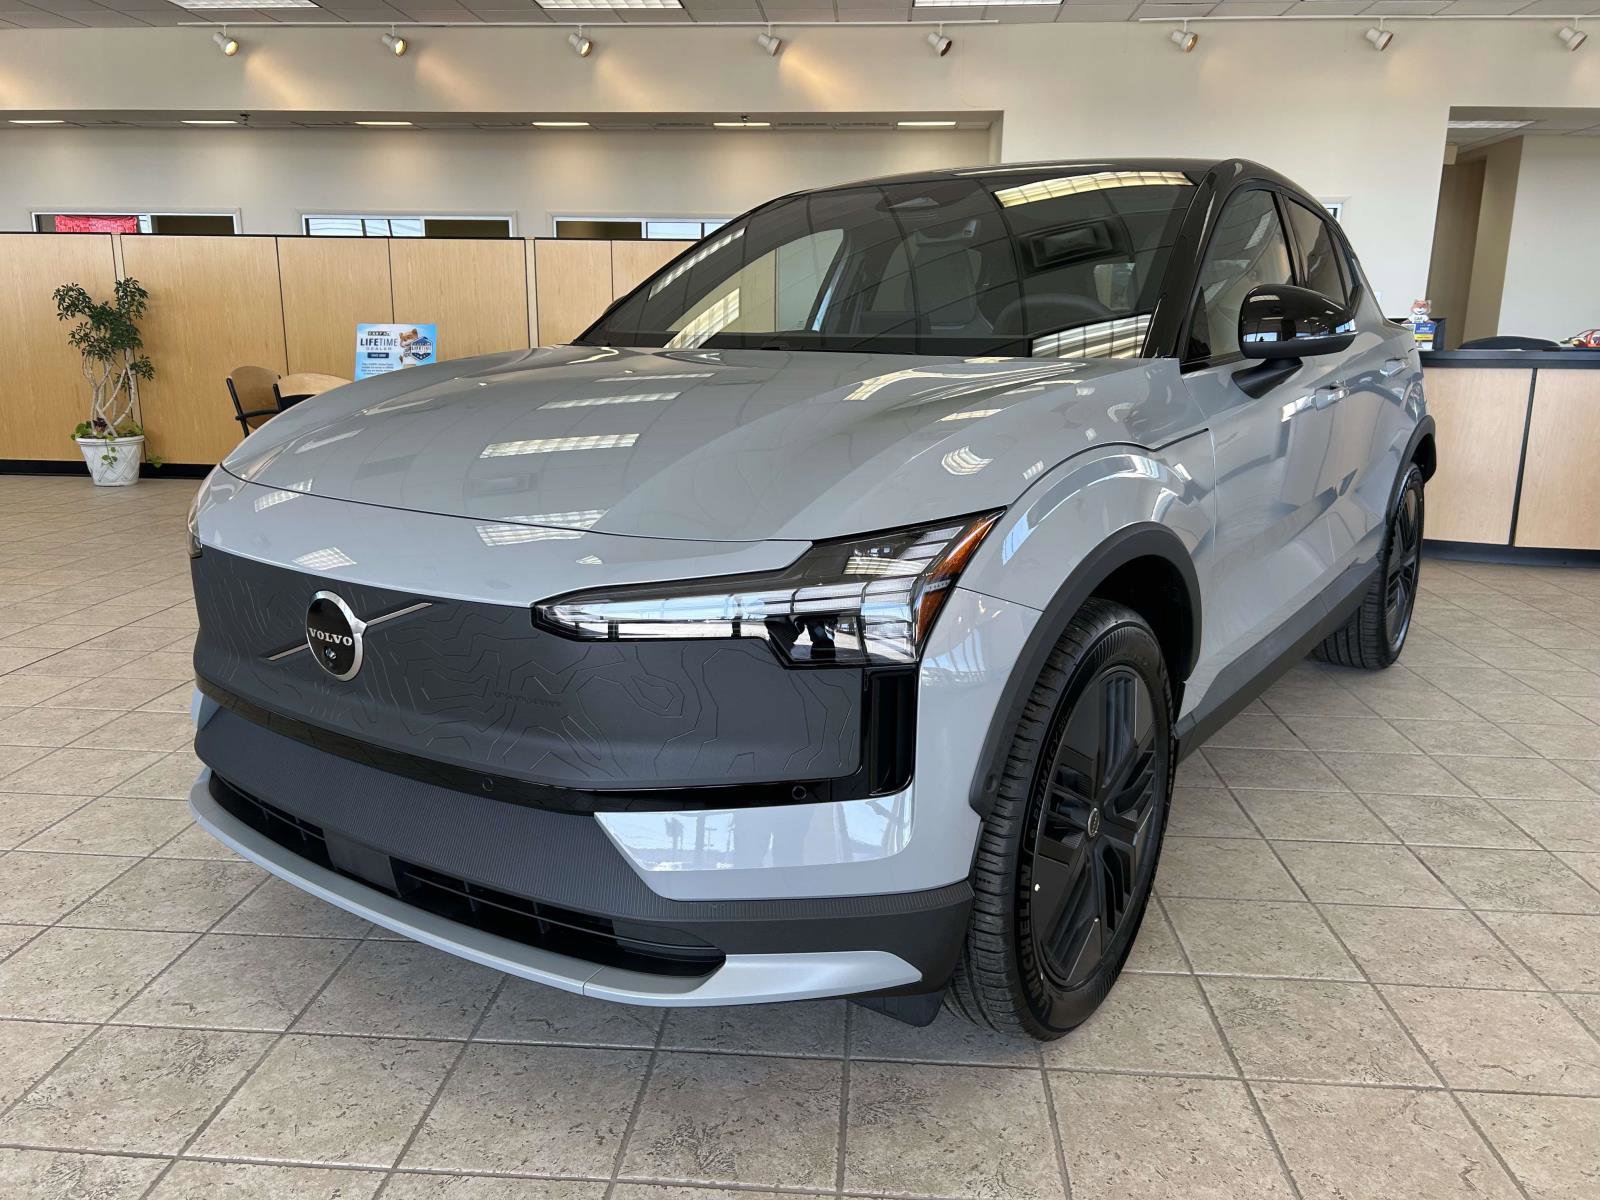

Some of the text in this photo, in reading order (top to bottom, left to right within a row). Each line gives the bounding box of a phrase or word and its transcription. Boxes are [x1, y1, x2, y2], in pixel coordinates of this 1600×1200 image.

[360, 338, 398, 347] LIFETIME
[308, 627, 353, 646] VOLVO
[1033, 732, 1059, 820] PRIMACY
[1018, 864, 1042, 998] MICHELIN
